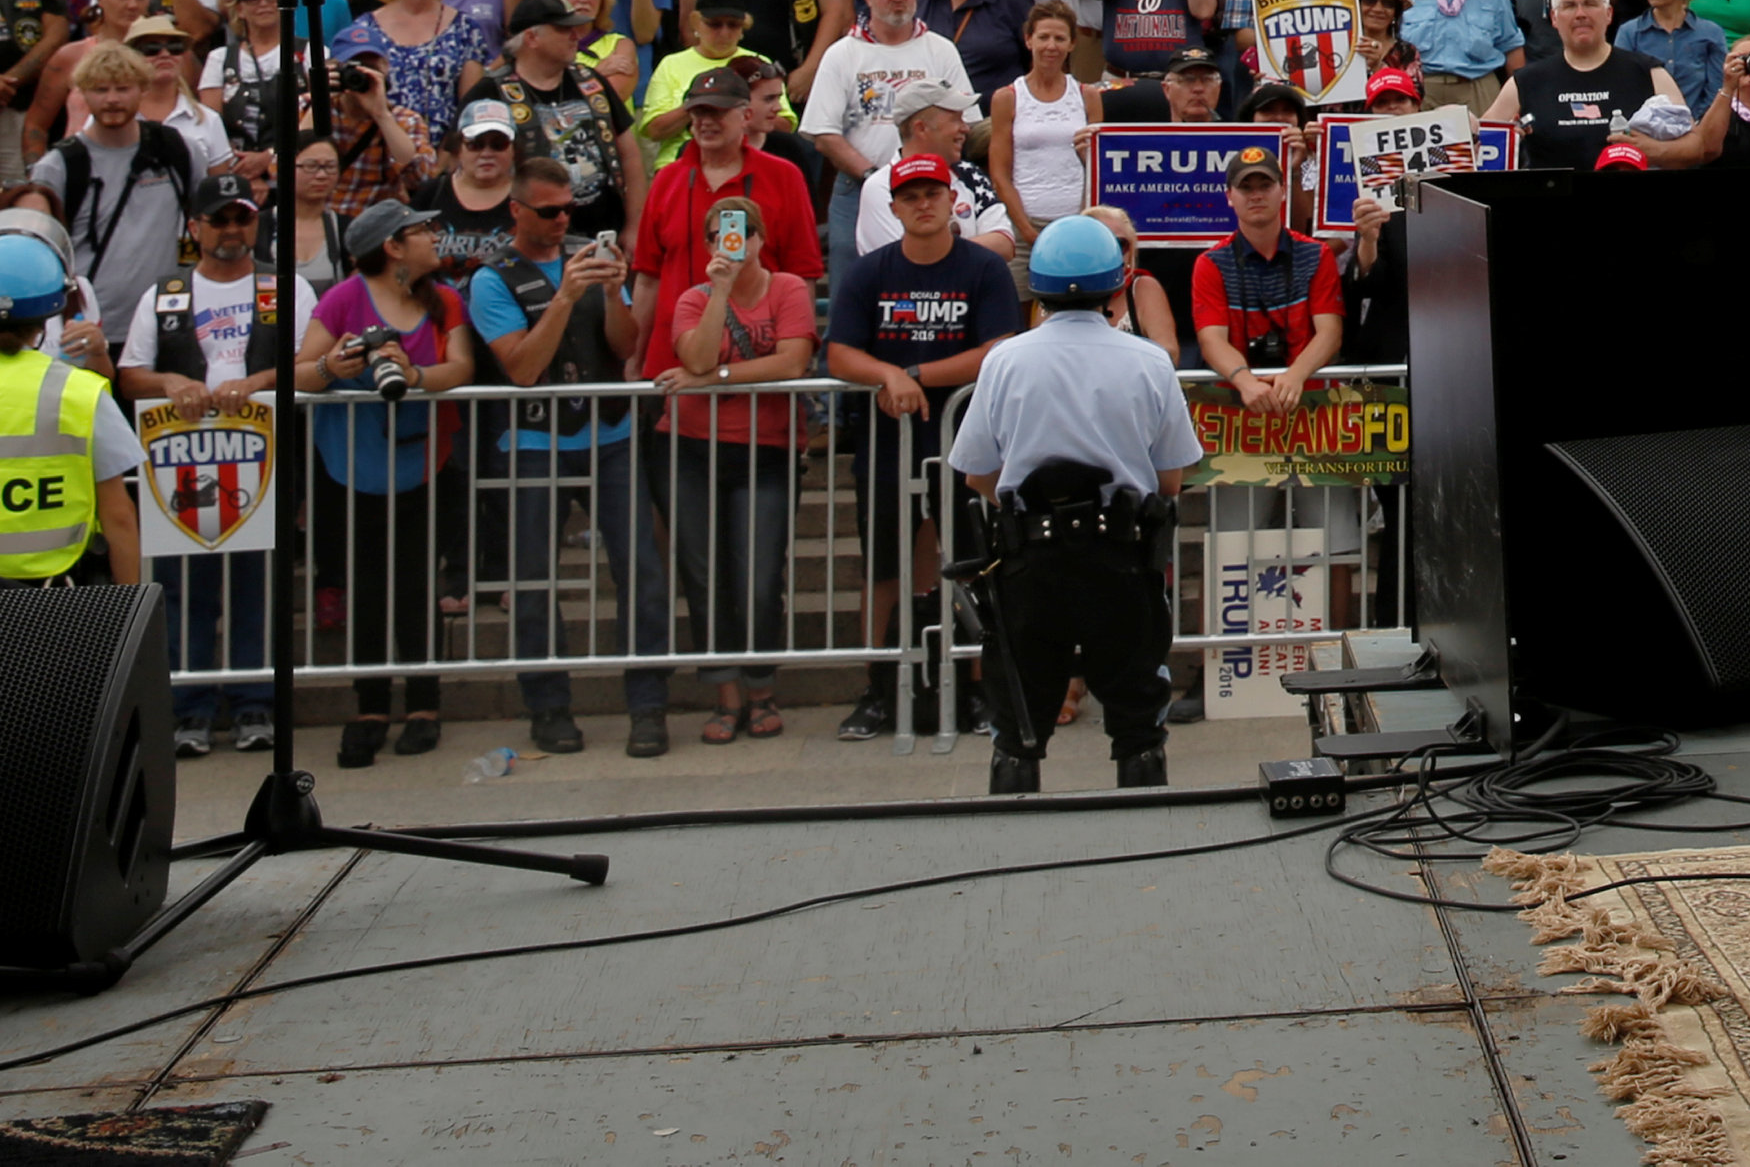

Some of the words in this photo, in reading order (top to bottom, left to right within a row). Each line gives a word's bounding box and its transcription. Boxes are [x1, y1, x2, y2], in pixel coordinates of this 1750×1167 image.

[1114, 14, 1187, 40] NATIONALS
[1264, 7, 1351, 40] TRUMP
[1558, 91, 1610, 103] OPERATION
[1377, 123, 1443, 153] FEDS
[1408, 151, 1427, 174] 4
[1105, 183, 1136, 193] MAKE
[1139, 183, 1190, 193] AMERICA
[1193, 183, 1229, 193] GREAT
[150, 432, 265, 466] TRUMP
[2, 475, 65, 513] CE
[1219, 666, 1233, 698] 2016
